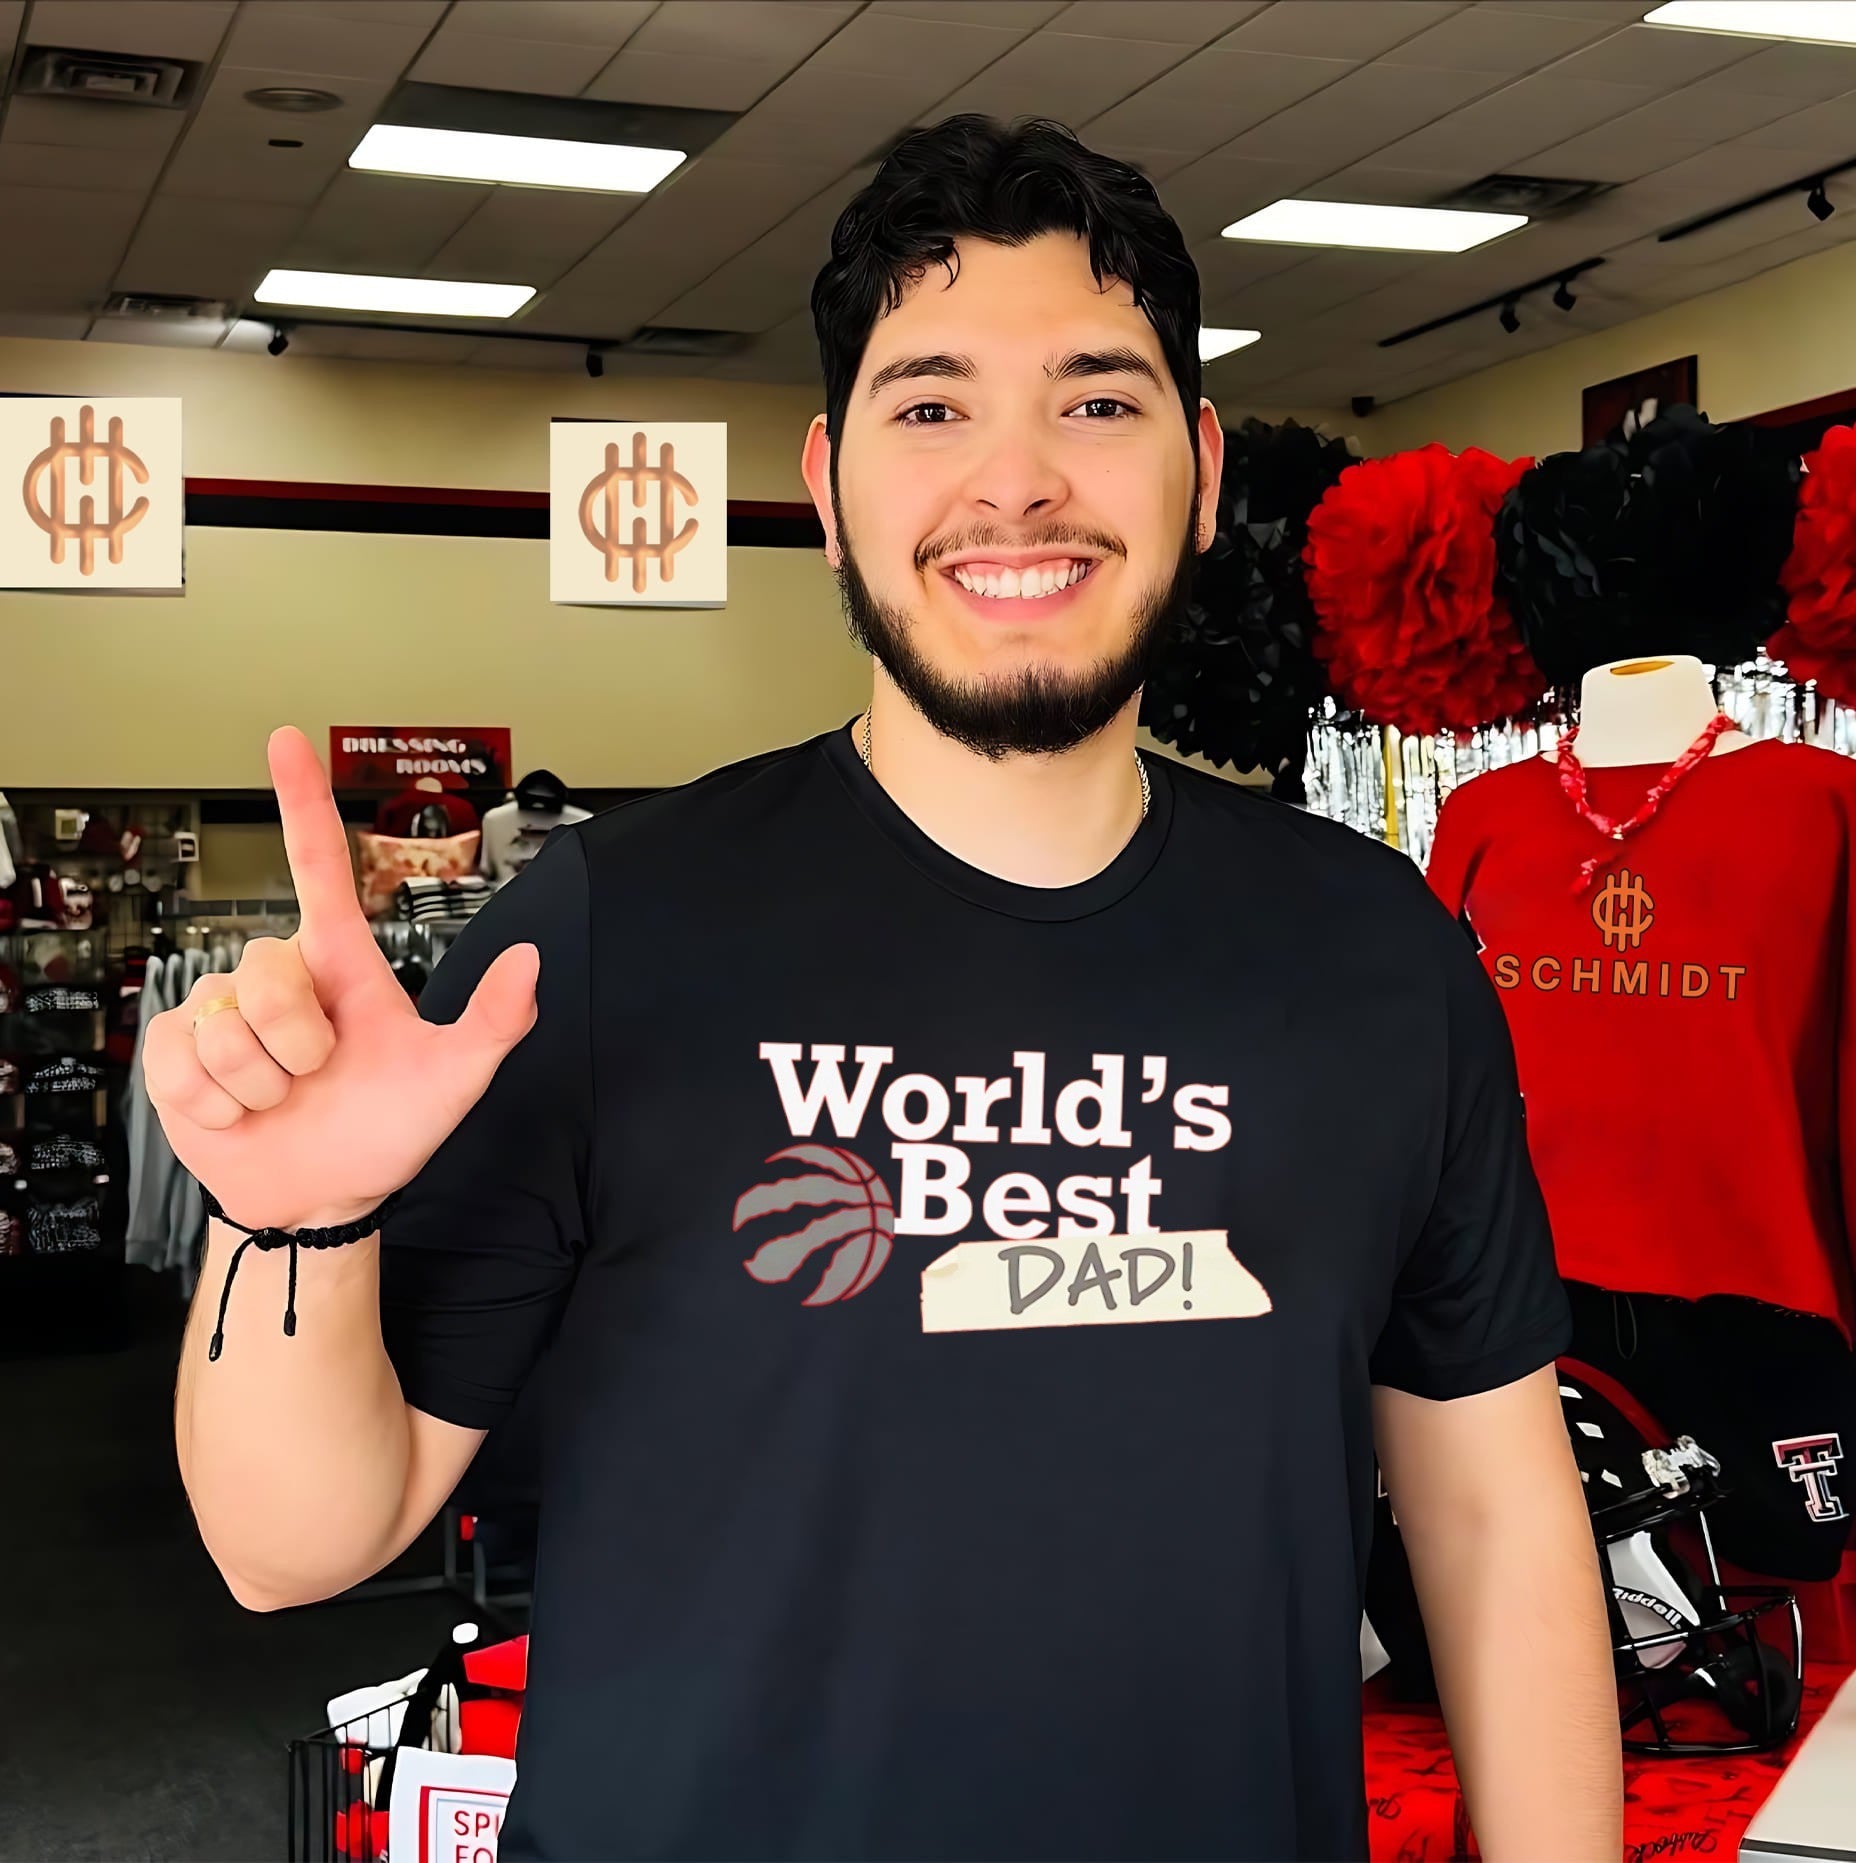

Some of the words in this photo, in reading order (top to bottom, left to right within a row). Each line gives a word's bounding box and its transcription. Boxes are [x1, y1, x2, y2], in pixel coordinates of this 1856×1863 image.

[341, 737, 467, 754] DRESSING
[395, 758, 487, 775] ROOMS
[1494, 954, 1747, 1000] SCHMIDT
[759, 1041, 1233, 1152] World's
[890, 1142, 1163, 1240] Best
[997, 1242, 1194, 1315] DAD!
